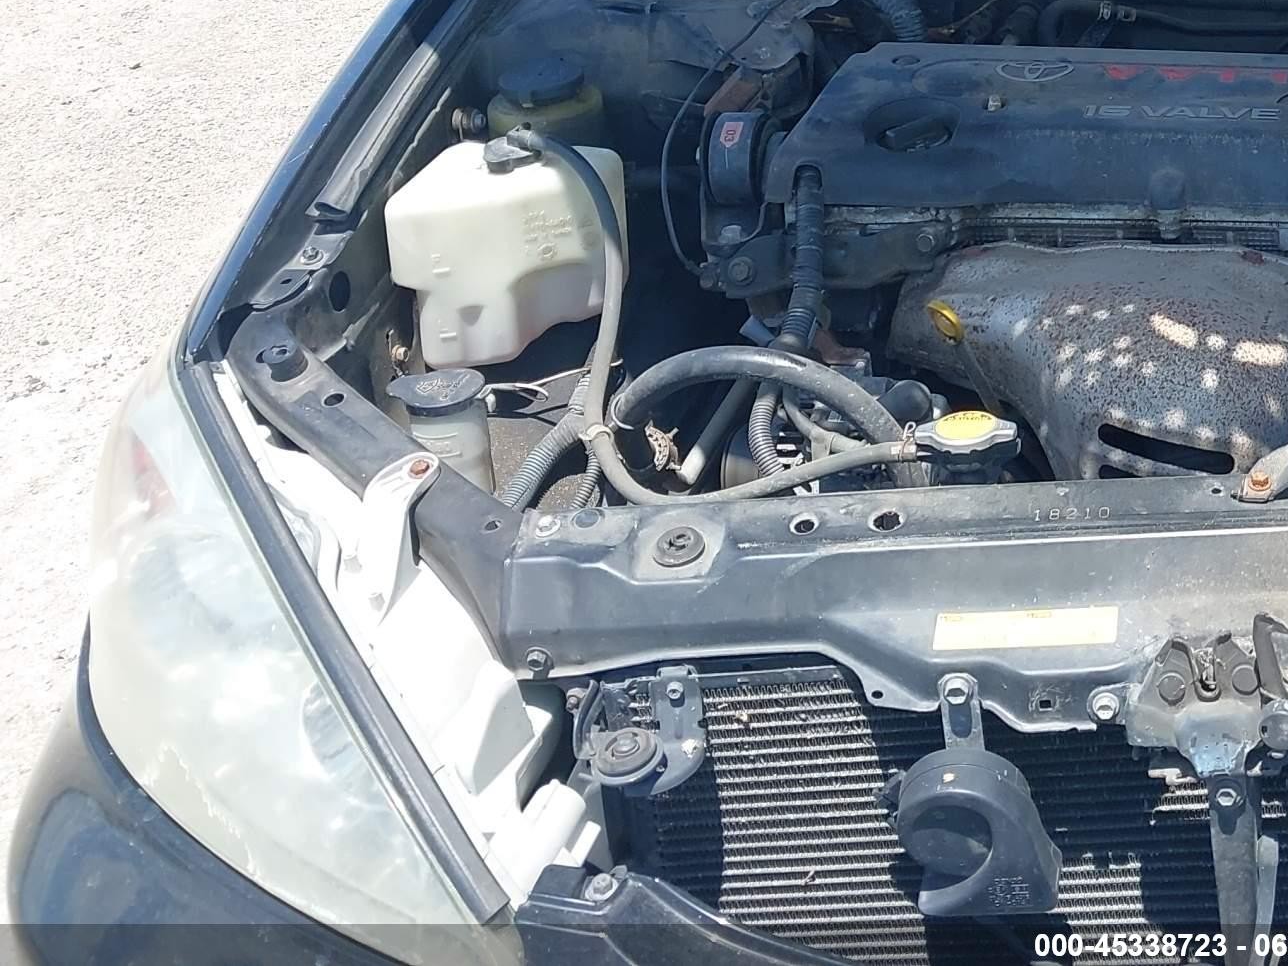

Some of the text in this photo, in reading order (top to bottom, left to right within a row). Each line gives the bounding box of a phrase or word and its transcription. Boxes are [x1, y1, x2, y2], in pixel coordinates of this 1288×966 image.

[1083, 104, 1282, 120] 16 VALVE
[1033, 506, 1112, 522] 18210
